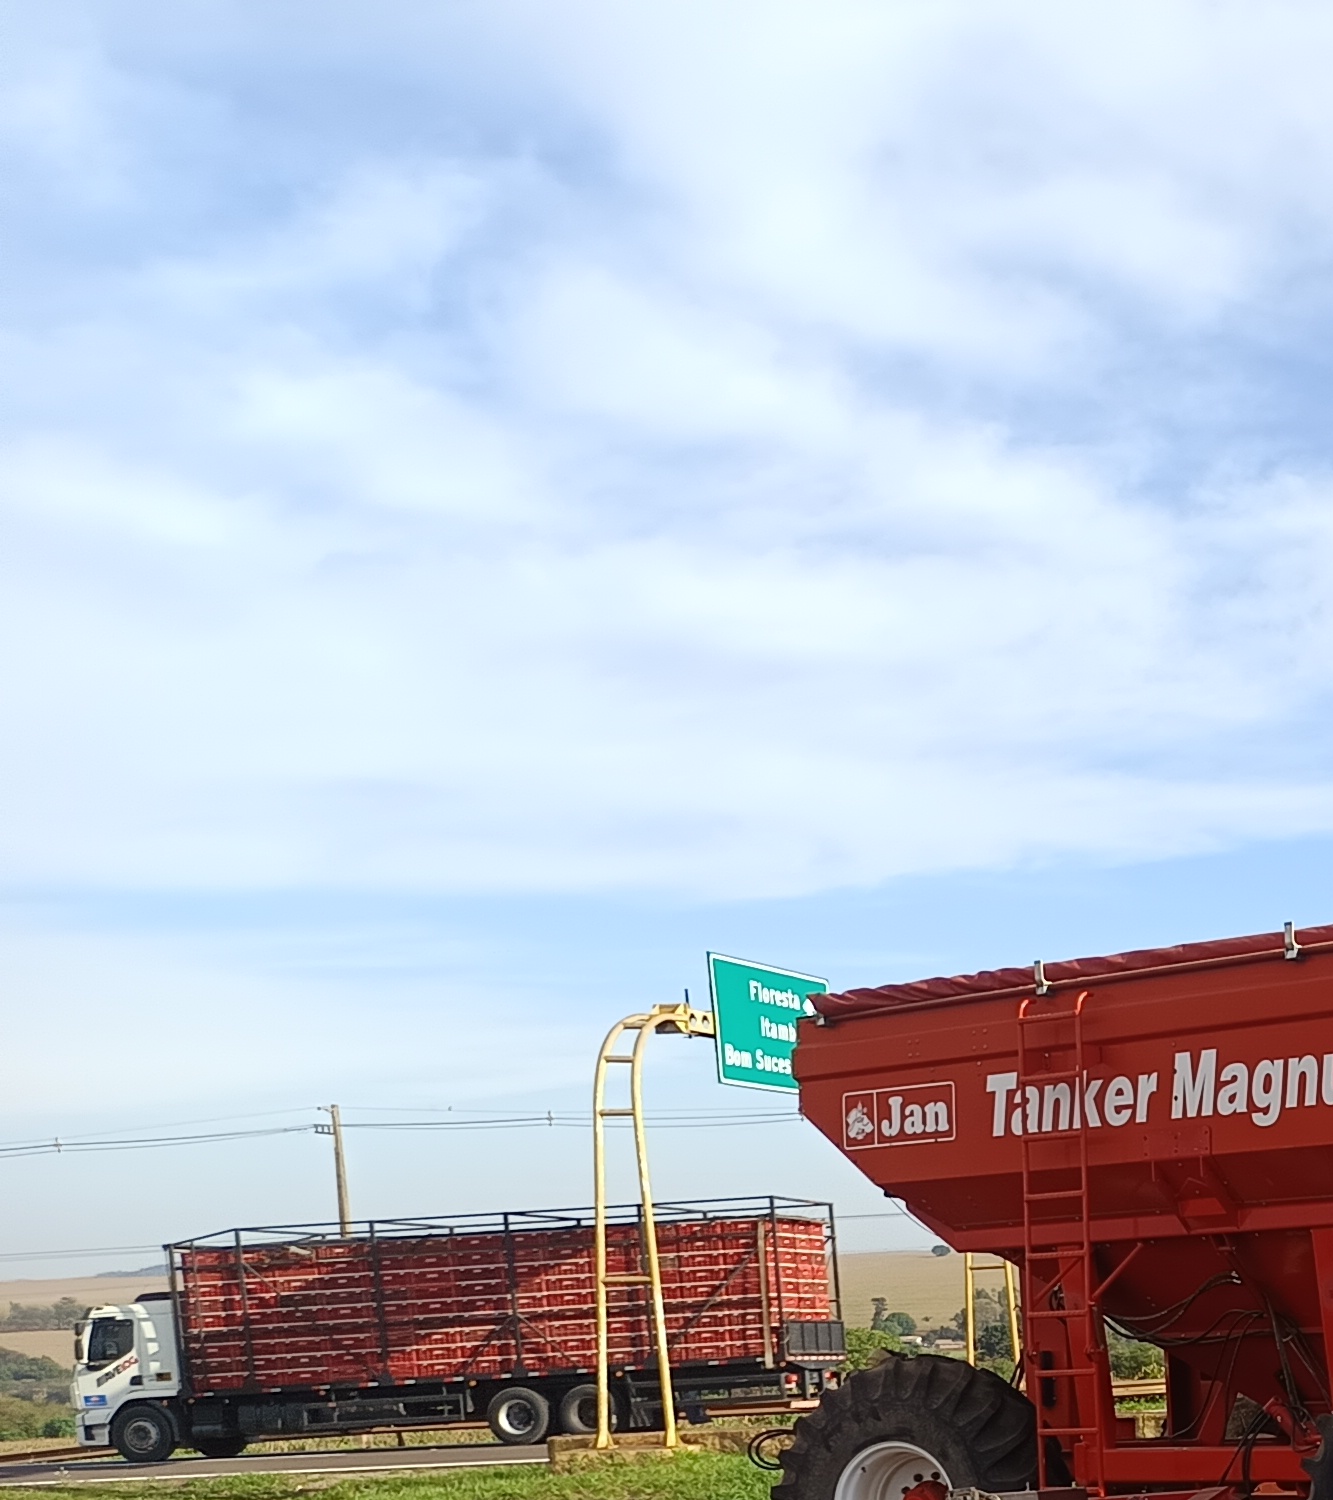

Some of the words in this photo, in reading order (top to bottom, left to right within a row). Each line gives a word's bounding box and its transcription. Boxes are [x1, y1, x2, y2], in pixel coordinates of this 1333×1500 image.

[748, 979, 800, 1011] Floresta
[760, 1015, 797, 1043] Itamb
[724, 1042, 753, 1069] Bom
[755, 1048, 792, 1075] Suces
[881, 1096, 949, 1137] Jan
[984, 1069, 1158, 1137] Tanker
